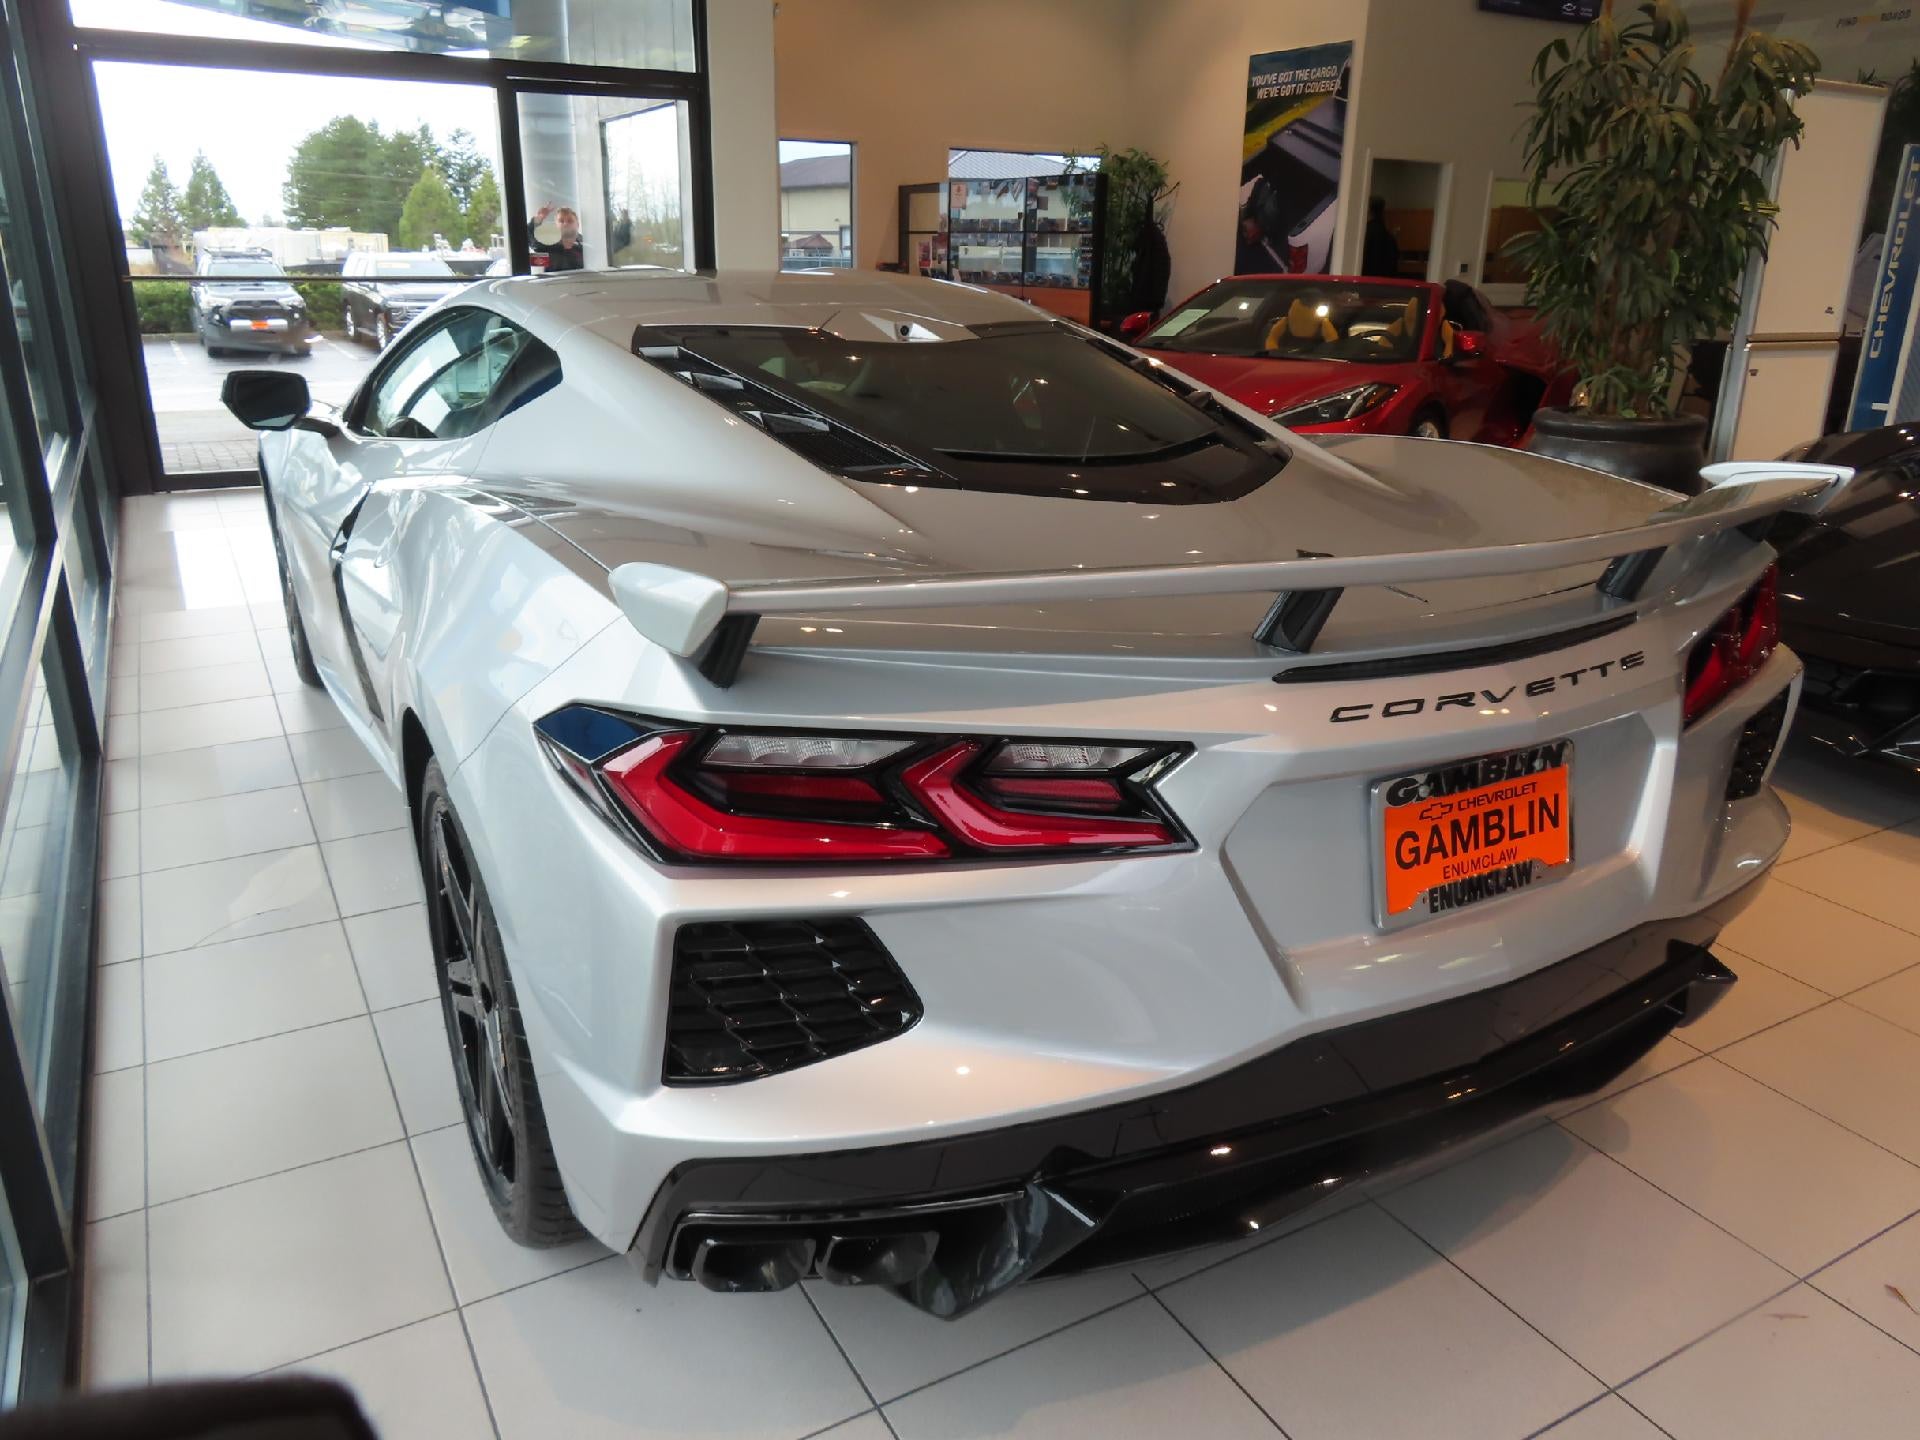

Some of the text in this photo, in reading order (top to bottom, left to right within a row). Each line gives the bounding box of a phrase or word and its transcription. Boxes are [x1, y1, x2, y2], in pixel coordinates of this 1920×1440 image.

[1252, 65, 1339, 87] YOU'VE GOT THE CARGO.
[1256, 85, 1281, 99] WE'VE
[1280, 83, 1297, 96] GOT
[1296, 82, 1305, 95] IT
[1869, 156, 1920, 359] CHEVROLET
[1330, 650, 1645, 723] CORVETTE
[1386, 741, 1565, 807] GAMBLIN
[1457, 781, 1538, 812] CHEVROLET
[1395, 793, 1560, 870] GAMBLIN
[1428, 860, 1533, 914] ENUMCLAW
[1442, 847, 1518, 880] ENUMCLAW
